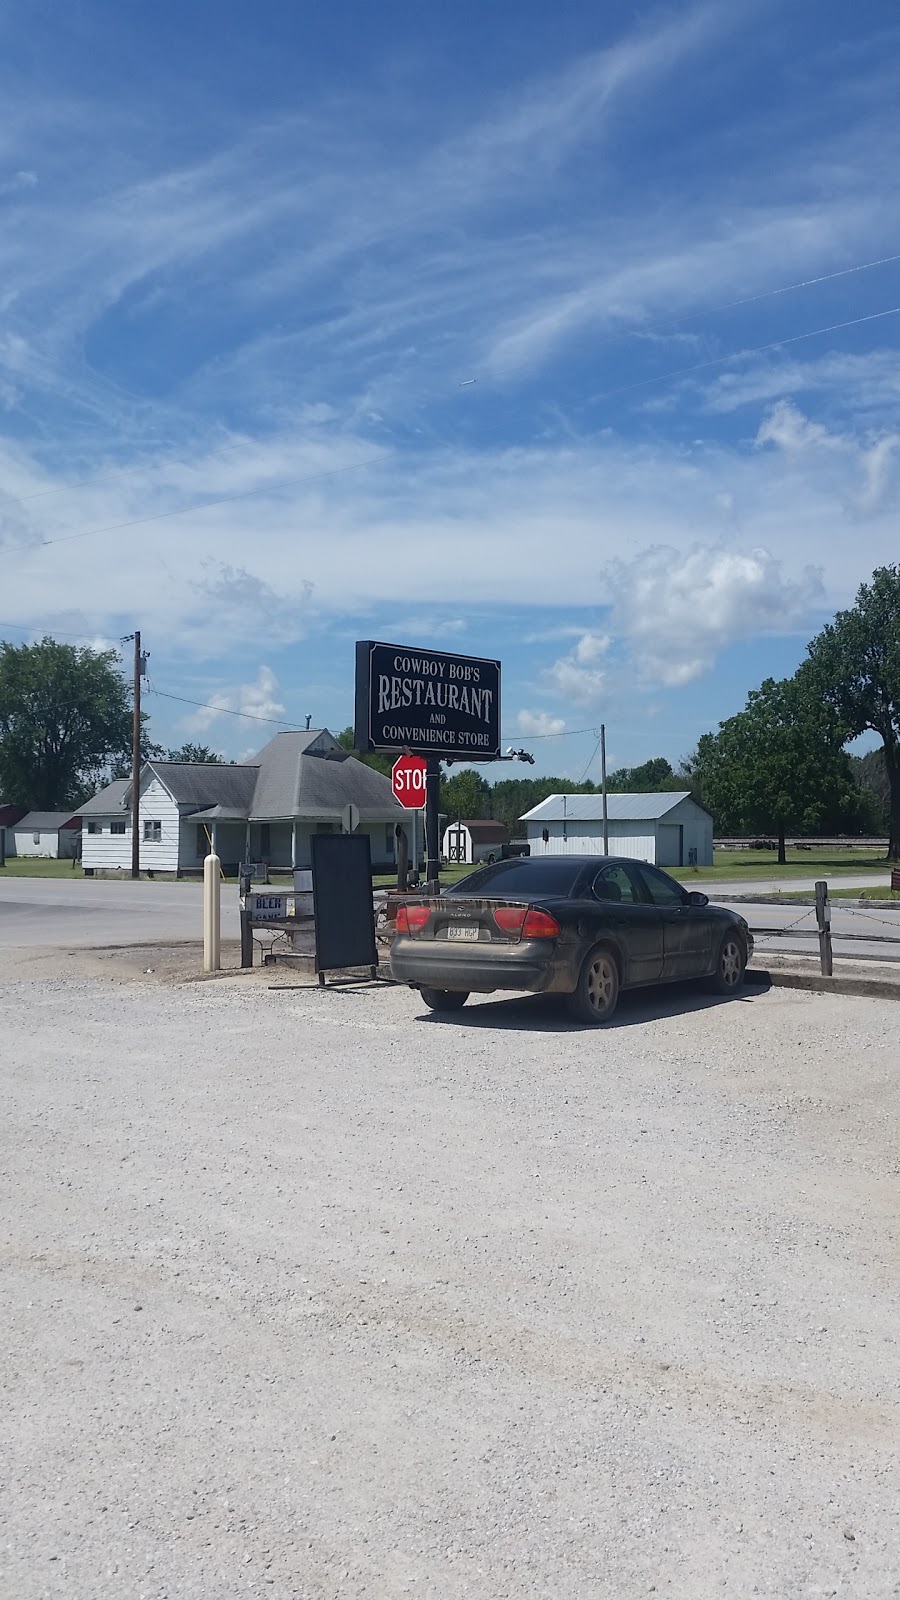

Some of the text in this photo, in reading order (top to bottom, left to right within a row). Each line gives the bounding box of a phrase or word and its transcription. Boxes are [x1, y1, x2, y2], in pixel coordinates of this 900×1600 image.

[393, 656, 480, 682] COWBOY BOB'S
[377, 674, 493, 724] RESTAURANT
[429, 713, 446, 725] AND
[382, 725, 490, 746] CONVENIENCE STORE
[256, 898, 281, 909] BEER
